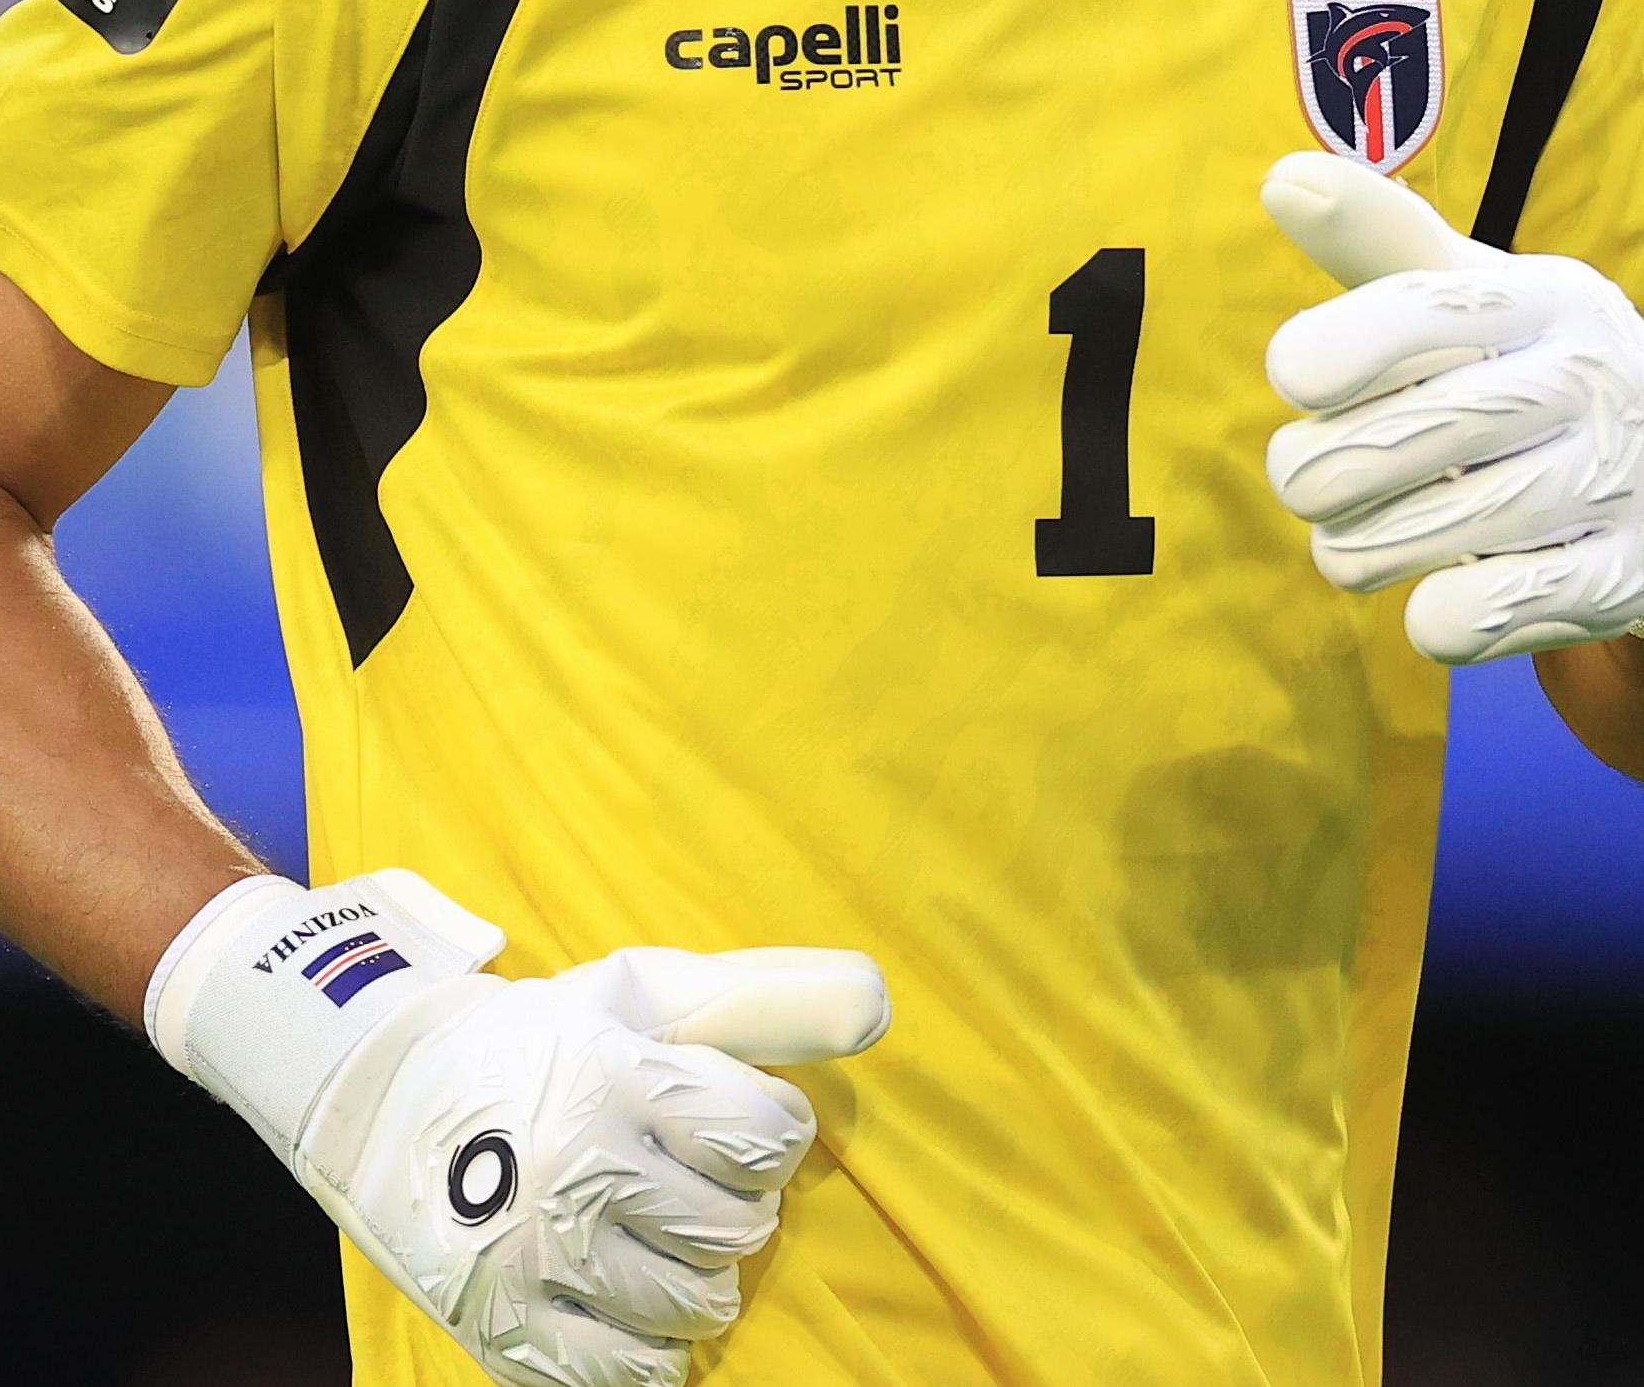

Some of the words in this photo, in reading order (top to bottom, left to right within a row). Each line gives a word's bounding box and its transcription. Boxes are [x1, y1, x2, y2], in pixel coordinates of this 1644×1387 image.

[664, 4, 901, 84] capelli
[779, 68, 902, 91] SPORT
[1034, 247, 1155, 577] 1
[251, 902, 380, 975] VOZINHA
